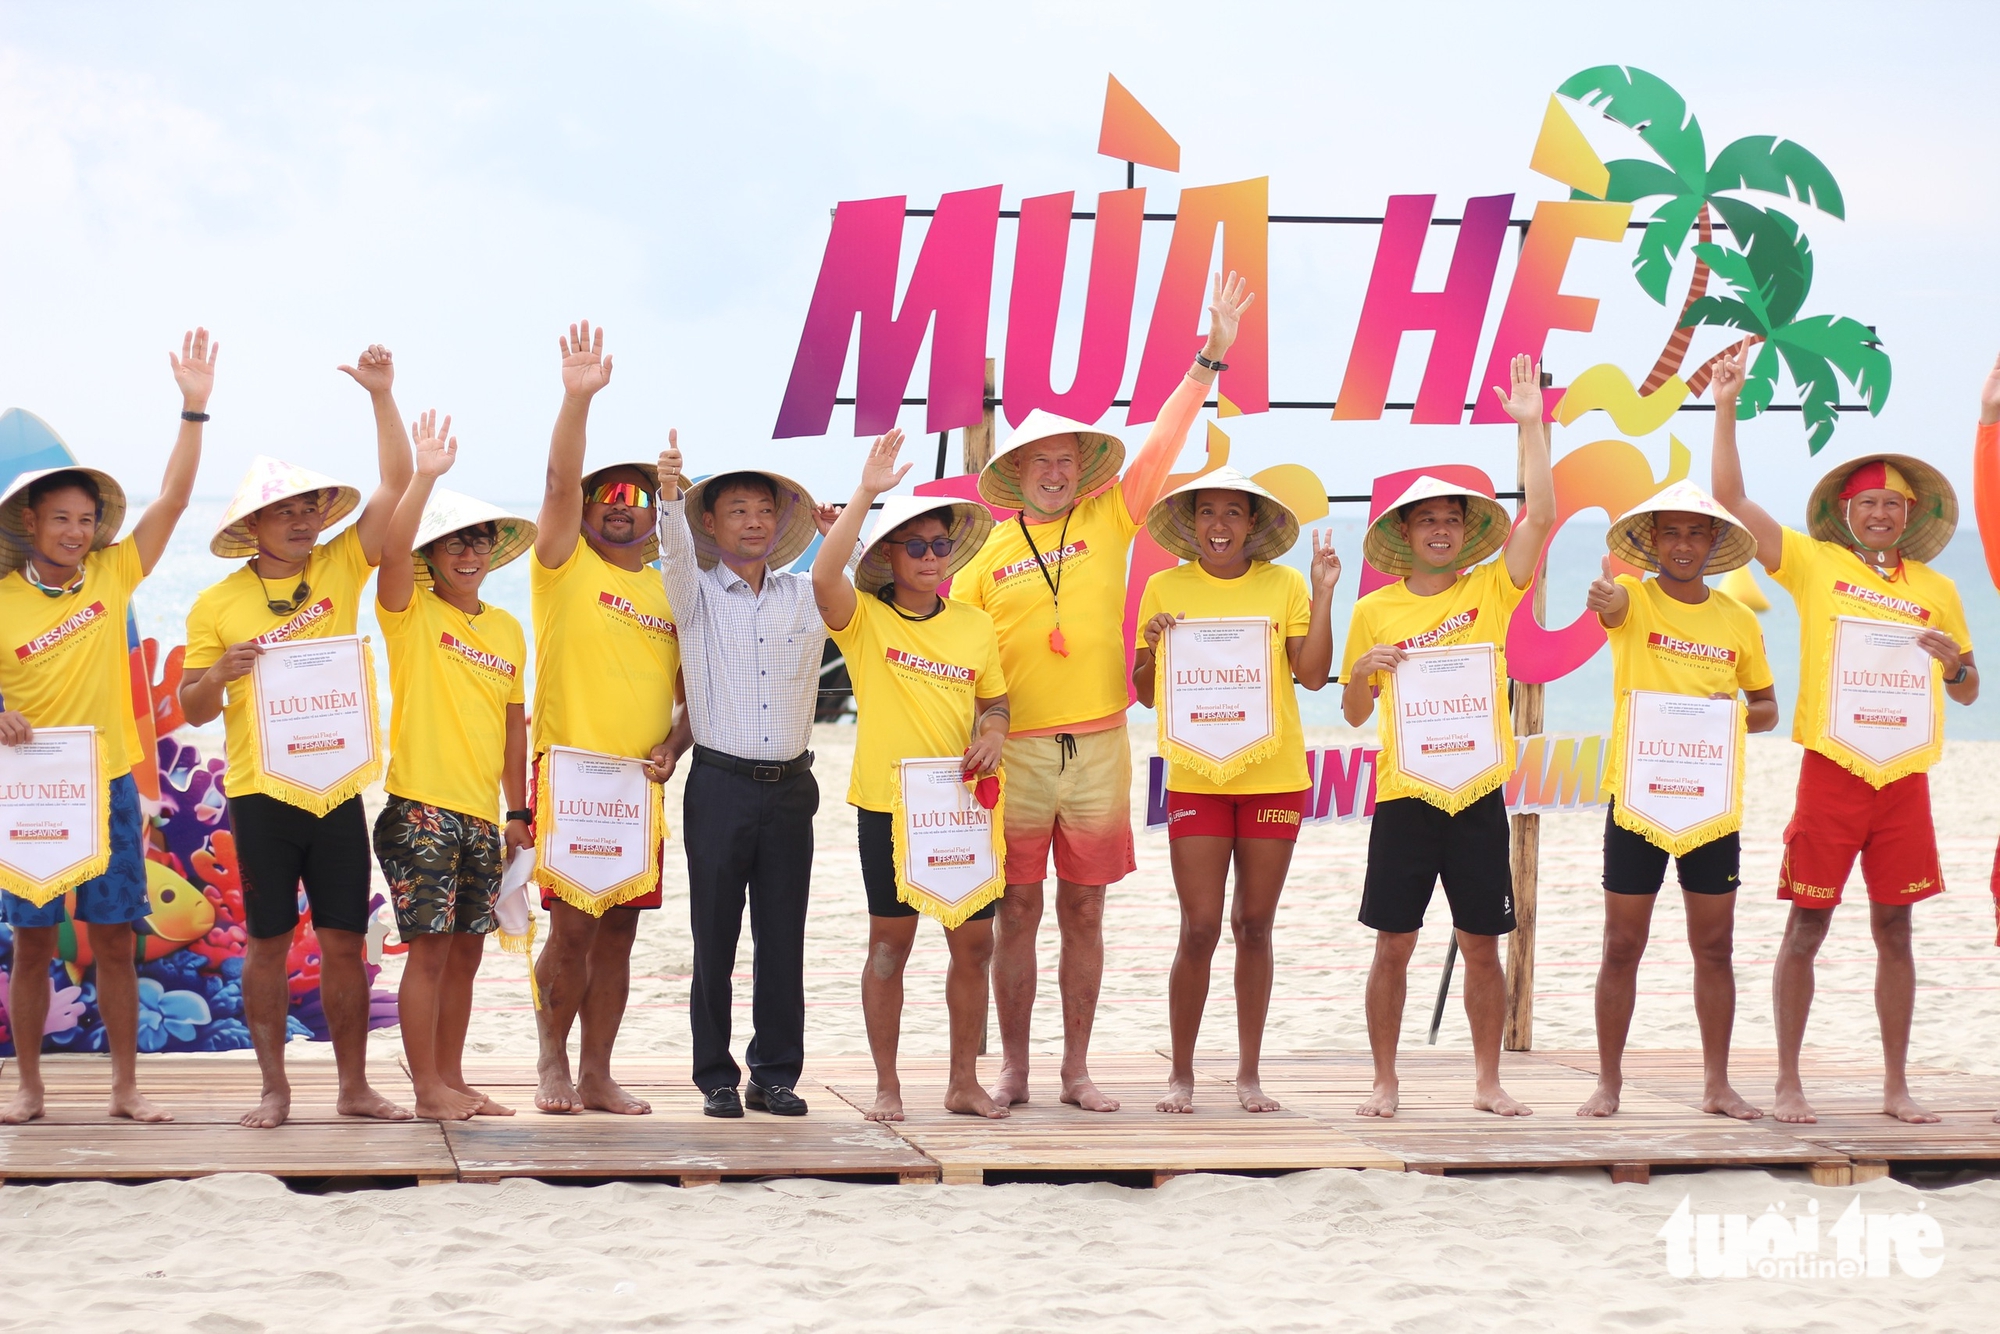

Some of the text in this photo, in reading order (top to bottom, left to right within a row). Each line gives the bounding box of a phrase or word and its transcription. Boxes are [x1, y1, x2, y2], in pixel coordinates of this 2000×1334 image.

[772, 71, 1634, 438] MÙA HÈ
[995, 549, 1090, 588] international hampionship
[598, 601, 639, 621] internation
[1832, 590, 1928, 627] international championship
[1846, 583, 1922, 616] LIFESAVING
[256, 603, 324, 645] LIFESAVING
[292, 608, 335, 638] championship
[612, 595, 673, 632] LIFEAVING
[20, 610, 108, 665] international championship
[27, 607, 95, 653] LIFESAVING
[1404, 612, 1471, 650] LIFESAVING
[453, 637, 512, 673] LIFESAVING
[1647, 643, 1736, 668] international championship
[1660, 635, 1729, 660] LIFESAVING
[885, 658, 975, 689] international championship
[898, 651, 969, 680] LIFESAVING
[1177, 664, 1261, 686] LƯU NIỆM
[924, 680, 949, 691] VIENAM
[1843, 669, 1926, 691] LƯU NIỆM
[269, 689, 357, 716] LƯU NIỆM
[1405, 693, 1488, 717] LƯU NIỆM
[1197, 711, 1239, 719] LIFESAVING
[1860, 714, 1901, 723] LIFESAVING
[293, 733, 320, 741] Memorial
[295, 739, 338, 750] LIFESAVING
[1428, 741, 1468, 750] LIFESAVING
[1639, 739, 1675, 757] LƯU
[1678, 739, 1723, 762] NIỆM
[38, 779, 86, 803] NIỆM
[1656, 784, 1698, 793] LIFESAVING
[558, 799, 640, 821] LƯU NIỆM
[912, 806, 987, 828] LƯU NIỆM
[1256, 809, 1301, 826] LIFEGUARD
[576, 844, 616, 852] LIFESAVING
[934, 854, 970, 863] LIFESAVING
[1807, 886, 1836, 899] RESCUE
